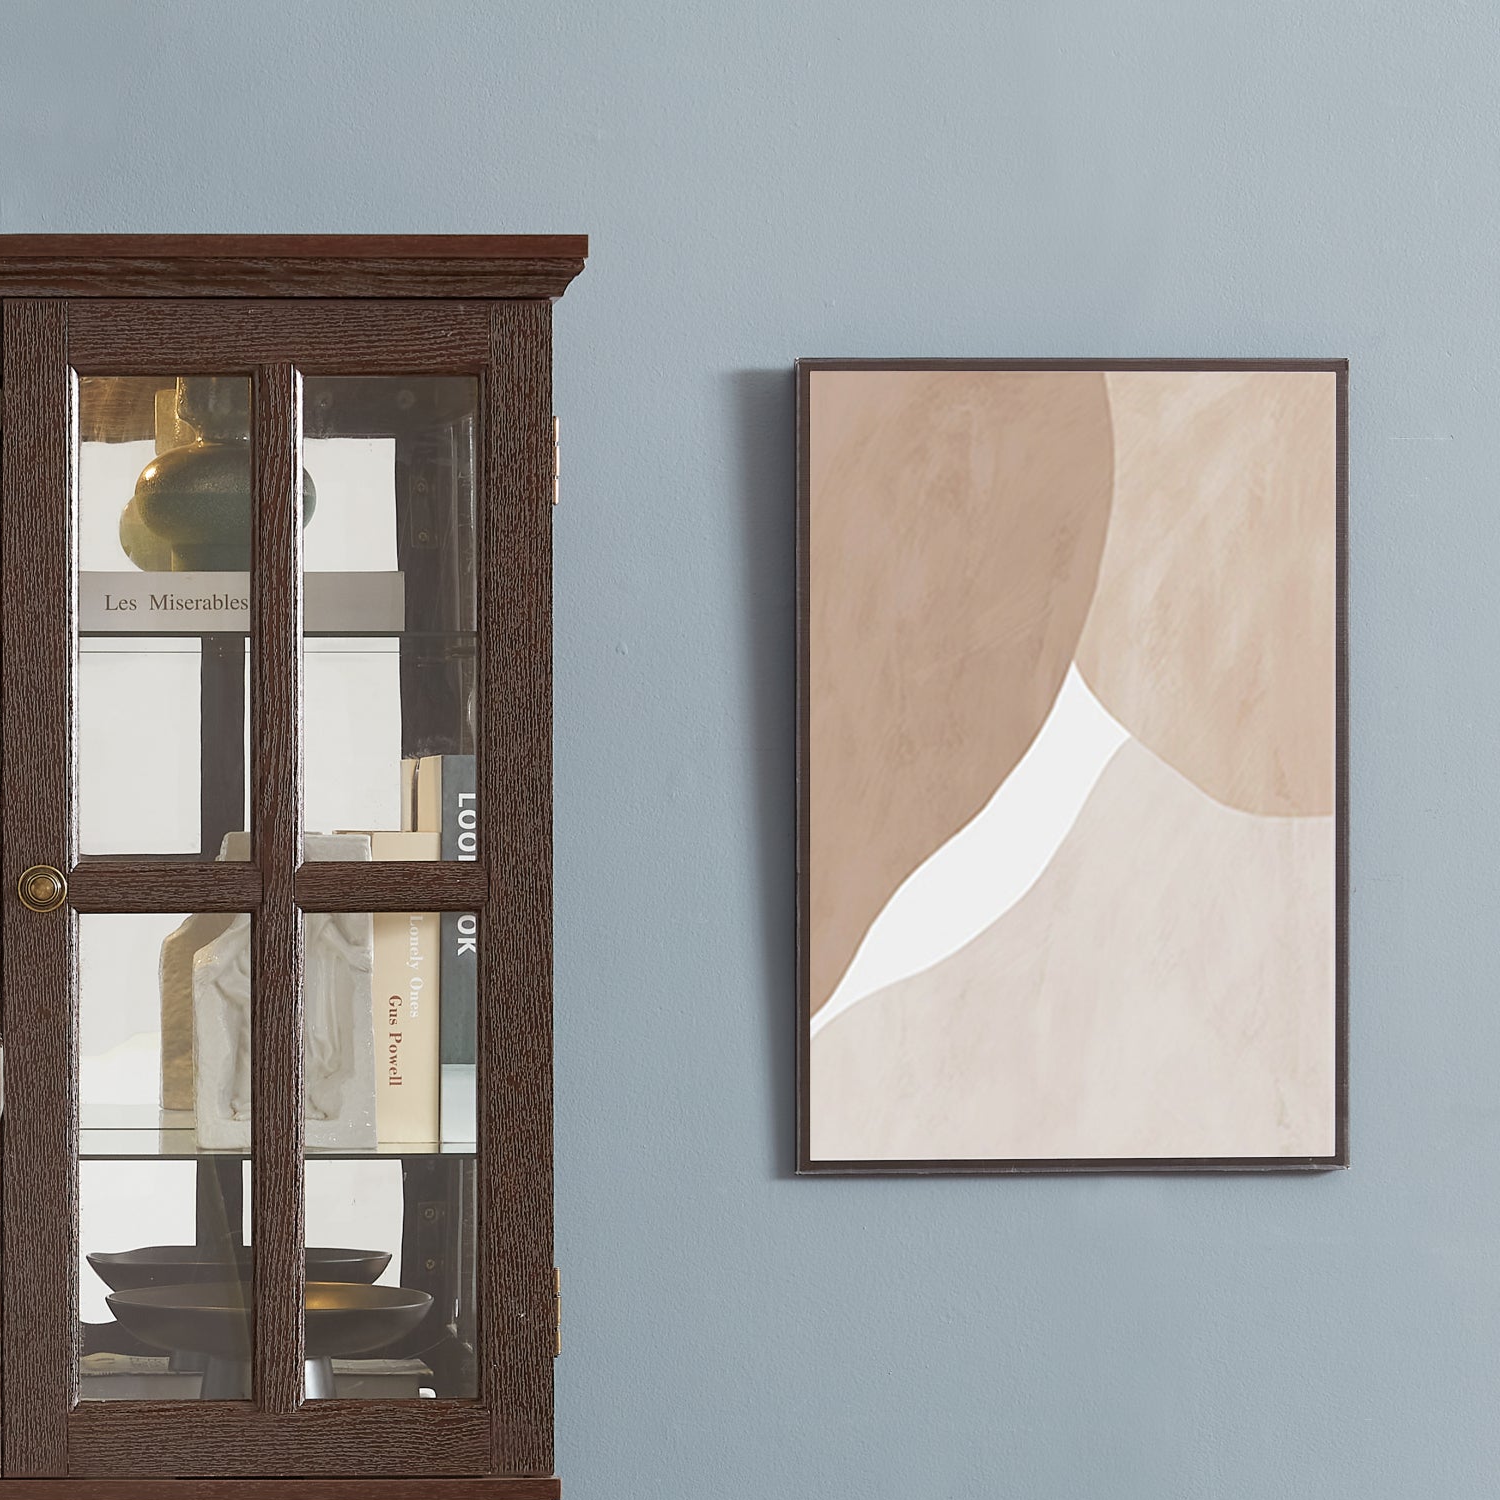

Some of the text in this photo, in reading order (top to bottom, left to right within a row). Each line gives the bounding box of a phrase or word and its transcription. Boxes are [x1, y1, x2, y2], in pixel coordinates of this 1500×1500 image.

[104, 593, 249, 611] Les Miserables
[406, 915, 424, 1018] Lonely Ones
[388, 995, 403, 1086] Gus Powell
